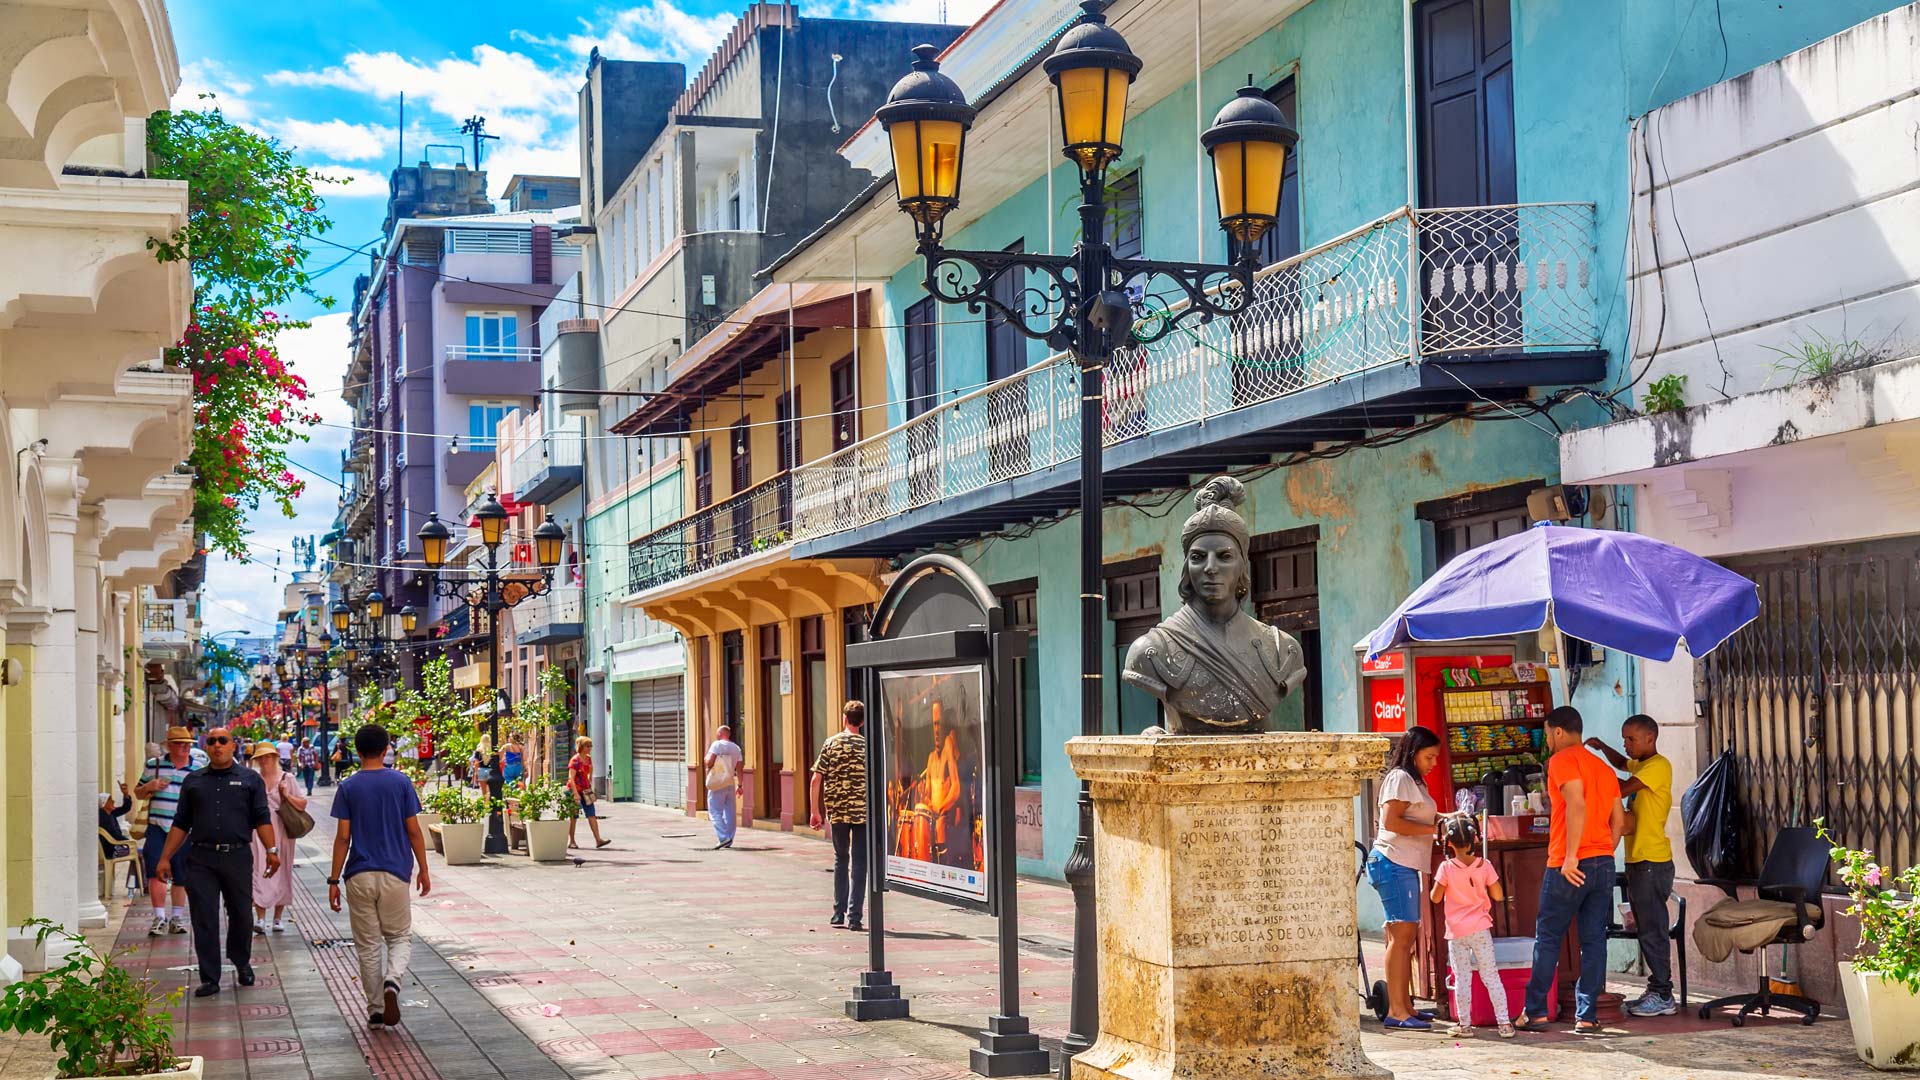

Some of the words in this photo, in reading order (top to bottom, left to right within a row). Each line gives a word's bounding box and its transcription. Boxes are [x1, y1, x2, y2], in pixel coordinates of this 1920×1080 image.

[1374, 701, 1402, 719] Claro
[420, 728, 430, 754] Claro
[1262, 804, 1295, 814] PRIMER
[1193, 820, 1205, 829] DE
[1253, 817, 1266, 827] AL
[1269, 814, 1332, 827] ADELANTADO
[1181, 831, 1209, 845] DON
[1245, 846, 1257, 854] LA
[1261, 843, 1299, 855] MARGEN
[1302, 840, 1349, 852] ORIENTAL
[1275, 856, 1286, 865] DE
[1289, 855, 1299, 864] LA
[1199, 871, 1210, 880] DE
[1213, 869, 1245, 879] SANTO
[1249, 867, 1297, 878] DOMINGO
[1221, 880, 1259, 890] AGOSTO
[1263, 879, 1280, 889] DEL
[1222, 893, 1252, 903] LUEGO
[1256, 891, 1271, 901] SER
[1275, 889, 1337, 900] TRASLADADA
[1272, 903, 1282, 912] EL
[1277, 928, 1293, 941] DE
[1297, 925, 1354, 940] OVANDO
[1243, 945, 1253, 954] EL
[1258, 942, 1280, 953] AÑO
